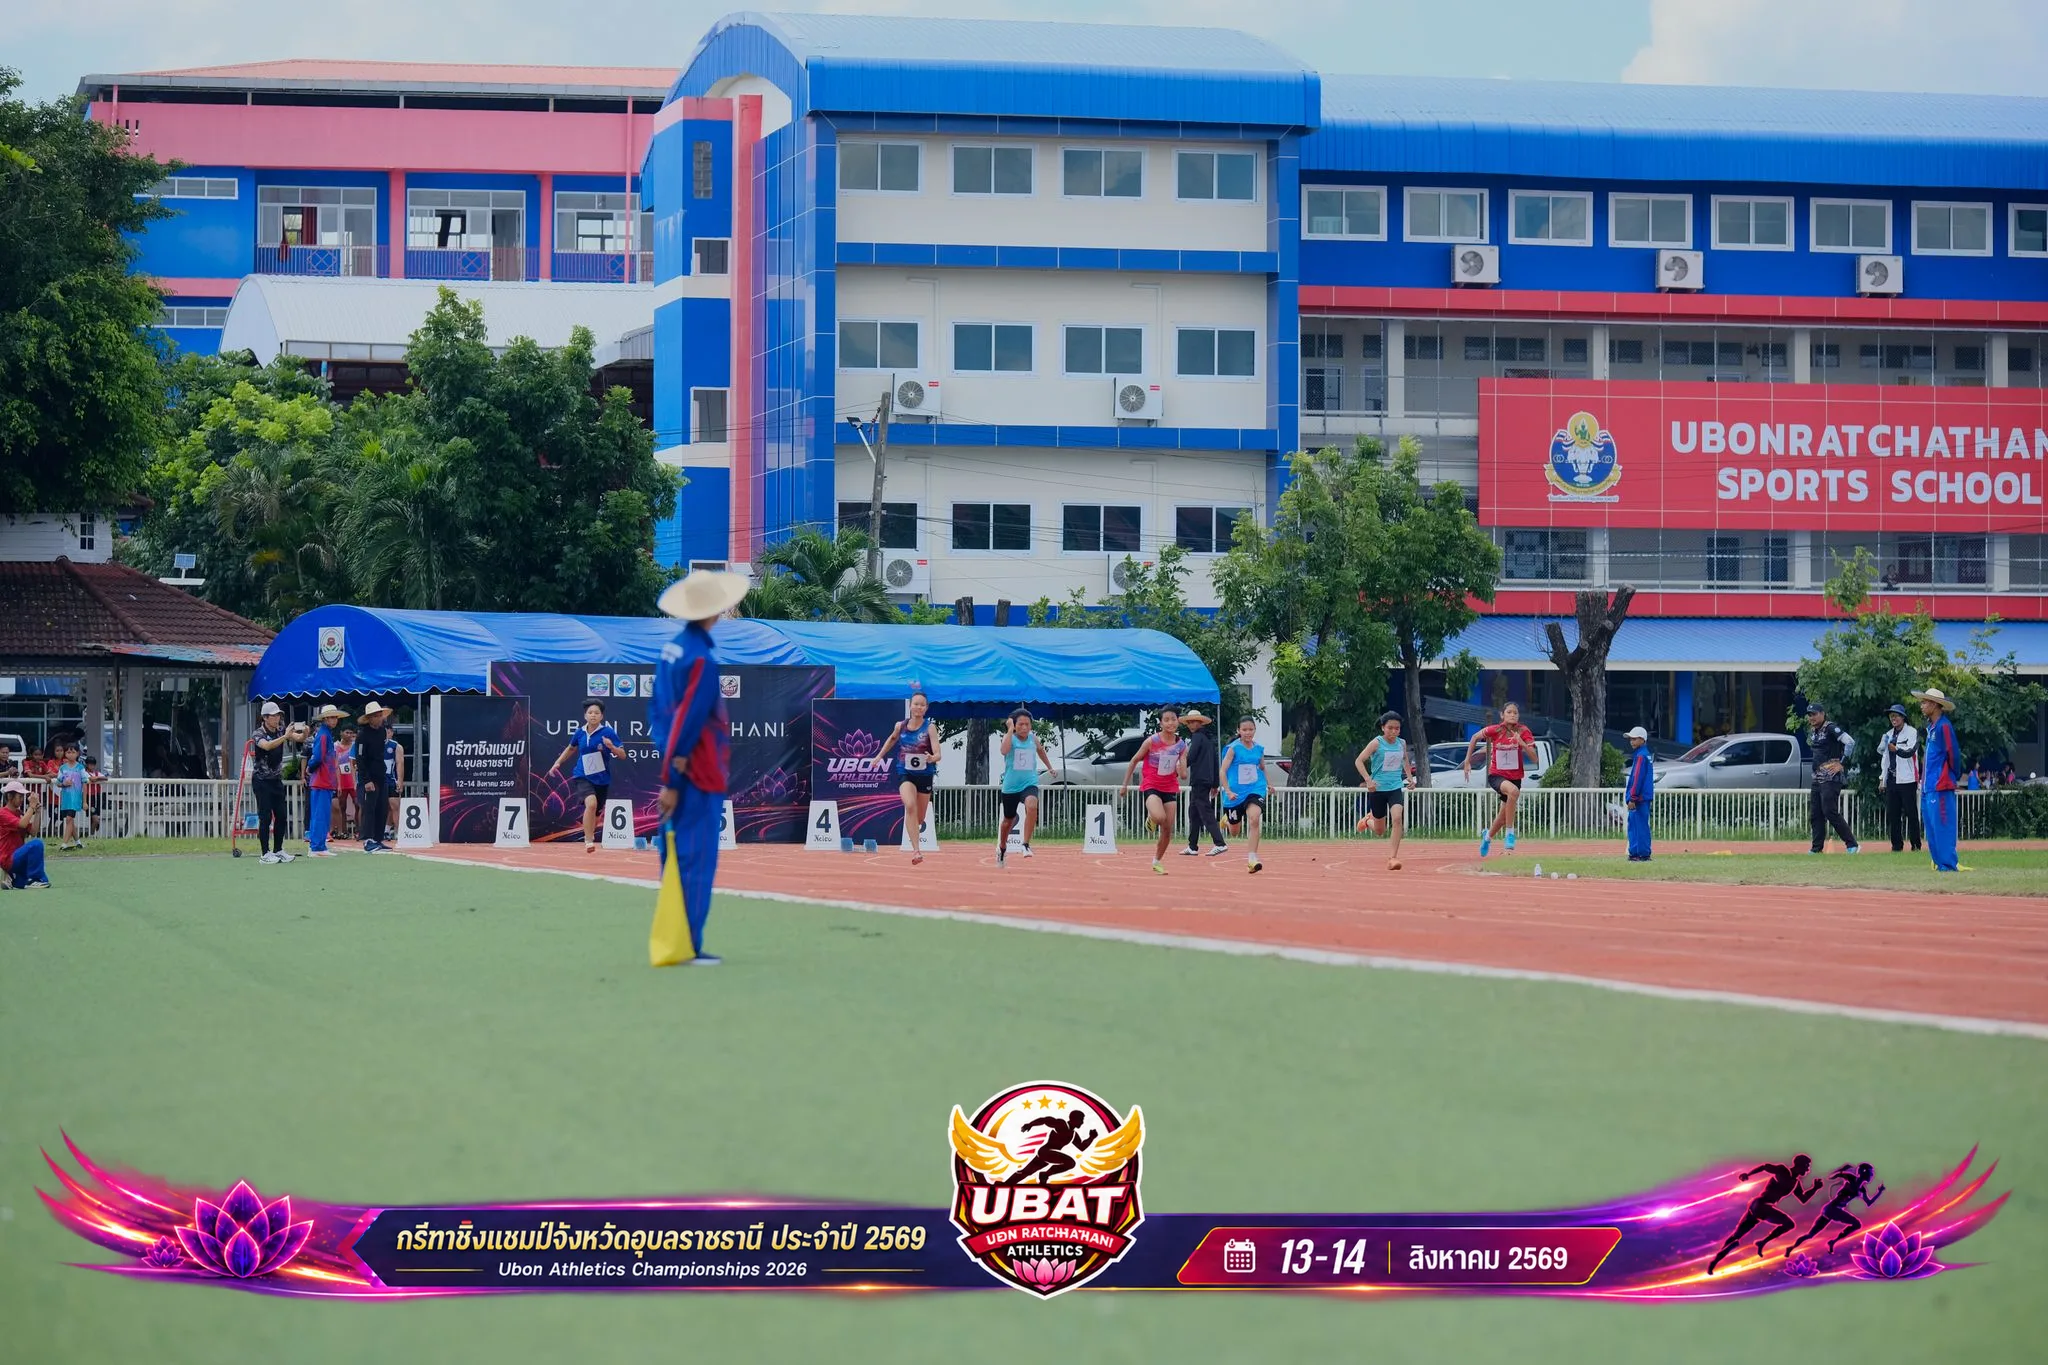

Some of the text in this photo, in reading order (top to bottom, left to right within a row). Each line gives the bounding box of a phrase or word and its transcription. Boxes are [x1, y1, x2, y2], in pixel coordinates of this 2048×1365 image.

[1717, 467, 2042, 505] SPORTS SCHOOL
[827, 757, 893, 773] UBON
[910, 757, 920, 768] 6
[1502, 752, 1511, 765] 1
[500, 780, 515, 788] 2569
[827, 773, 891, 782] ATHLETICS
[406, 806, 422, 830] 8
[505, 806, 521, 830] 7
[611, 806, 627, 830] 6
[816, 809, 831, 833] 4
[1094, 812, 1105, 836] 1
